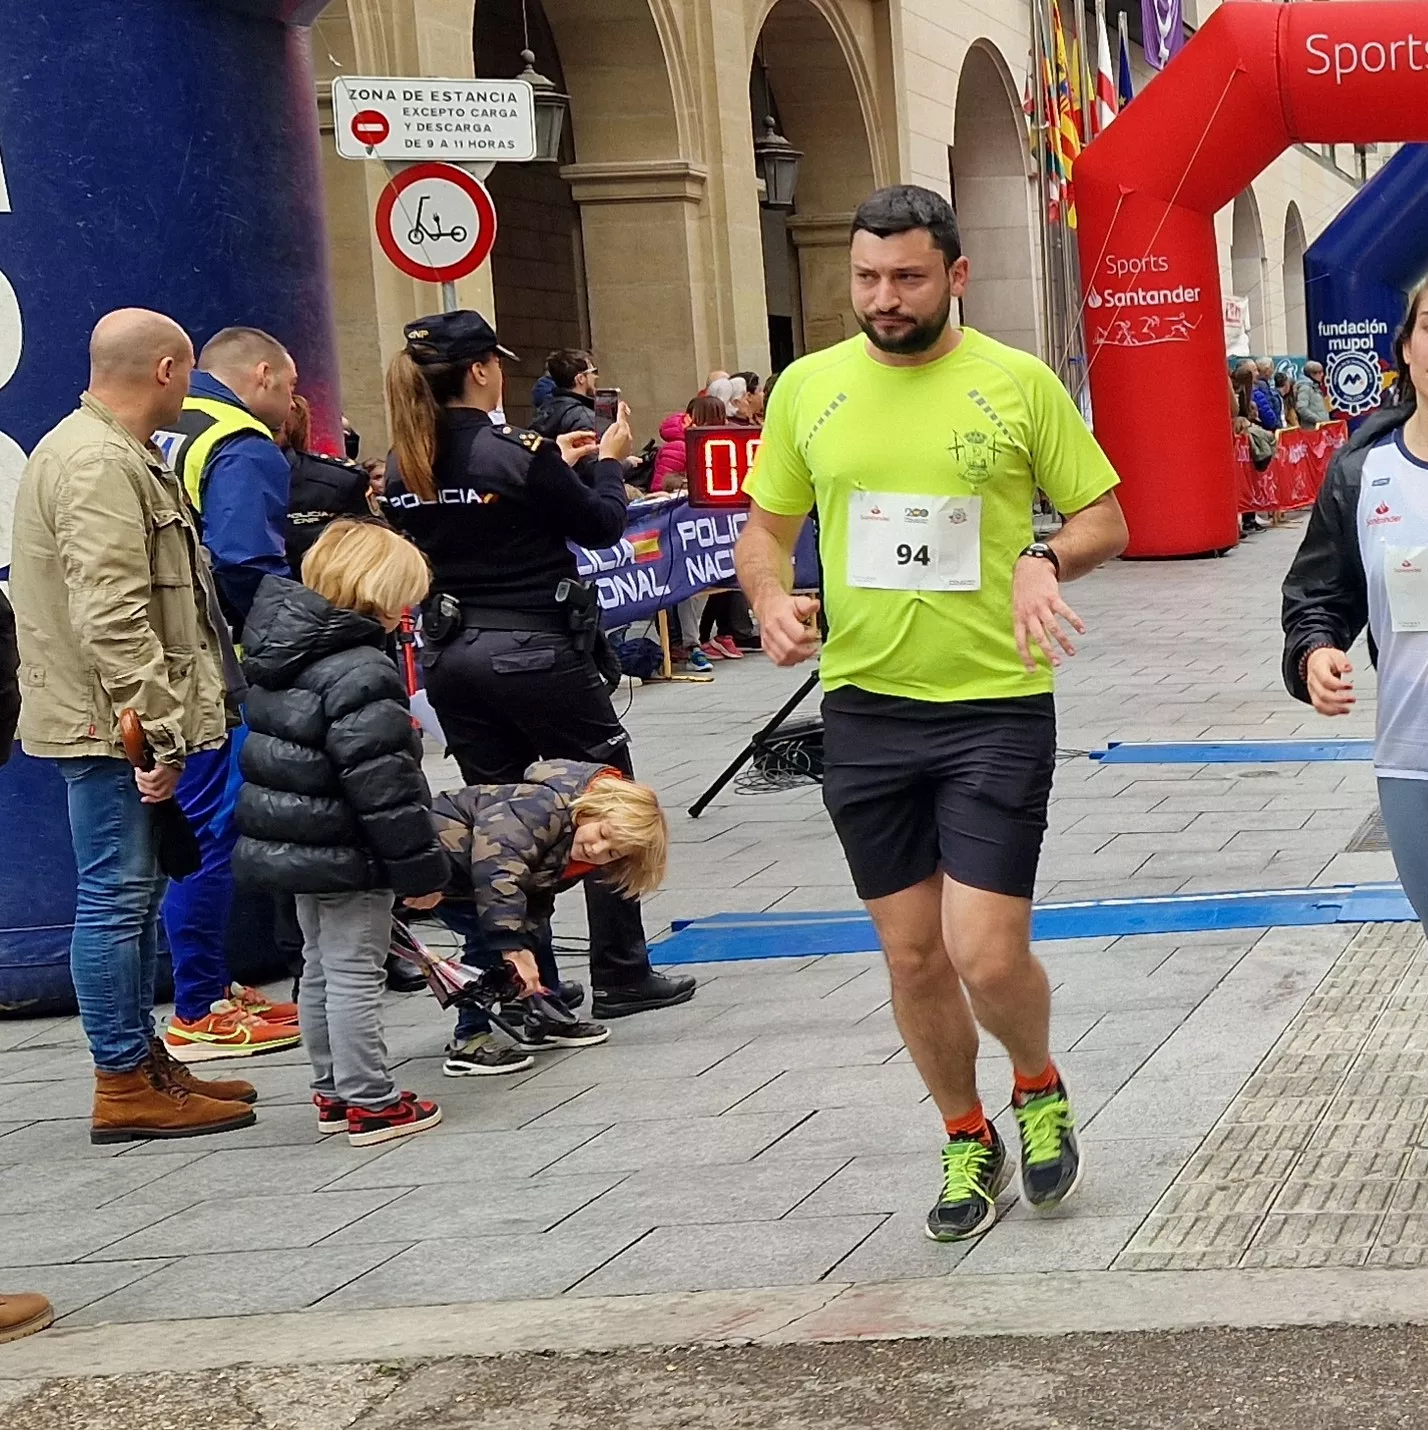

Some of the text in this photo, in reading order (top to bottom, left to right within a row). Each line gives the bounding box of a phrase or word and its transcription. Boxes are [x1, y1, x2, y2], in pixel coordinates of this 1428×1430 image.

[349, 89, 518, 103] ZONA DE ESTANCIA
[403, 107, 518, 119] EXCEPTO CARGA
[404, 123, 492, 133] Y DESCARGA
[404, 139, 515, 149] DE 9 A 11 HORAS
[1106, 255, 1169, 278] Sports
[1104, 285, 1200, 308] Santander
[1318, 318, 1388, 336] fundación
[1329, 334, 1374, 351] mupol
[896, 543, 931, 566] 94
